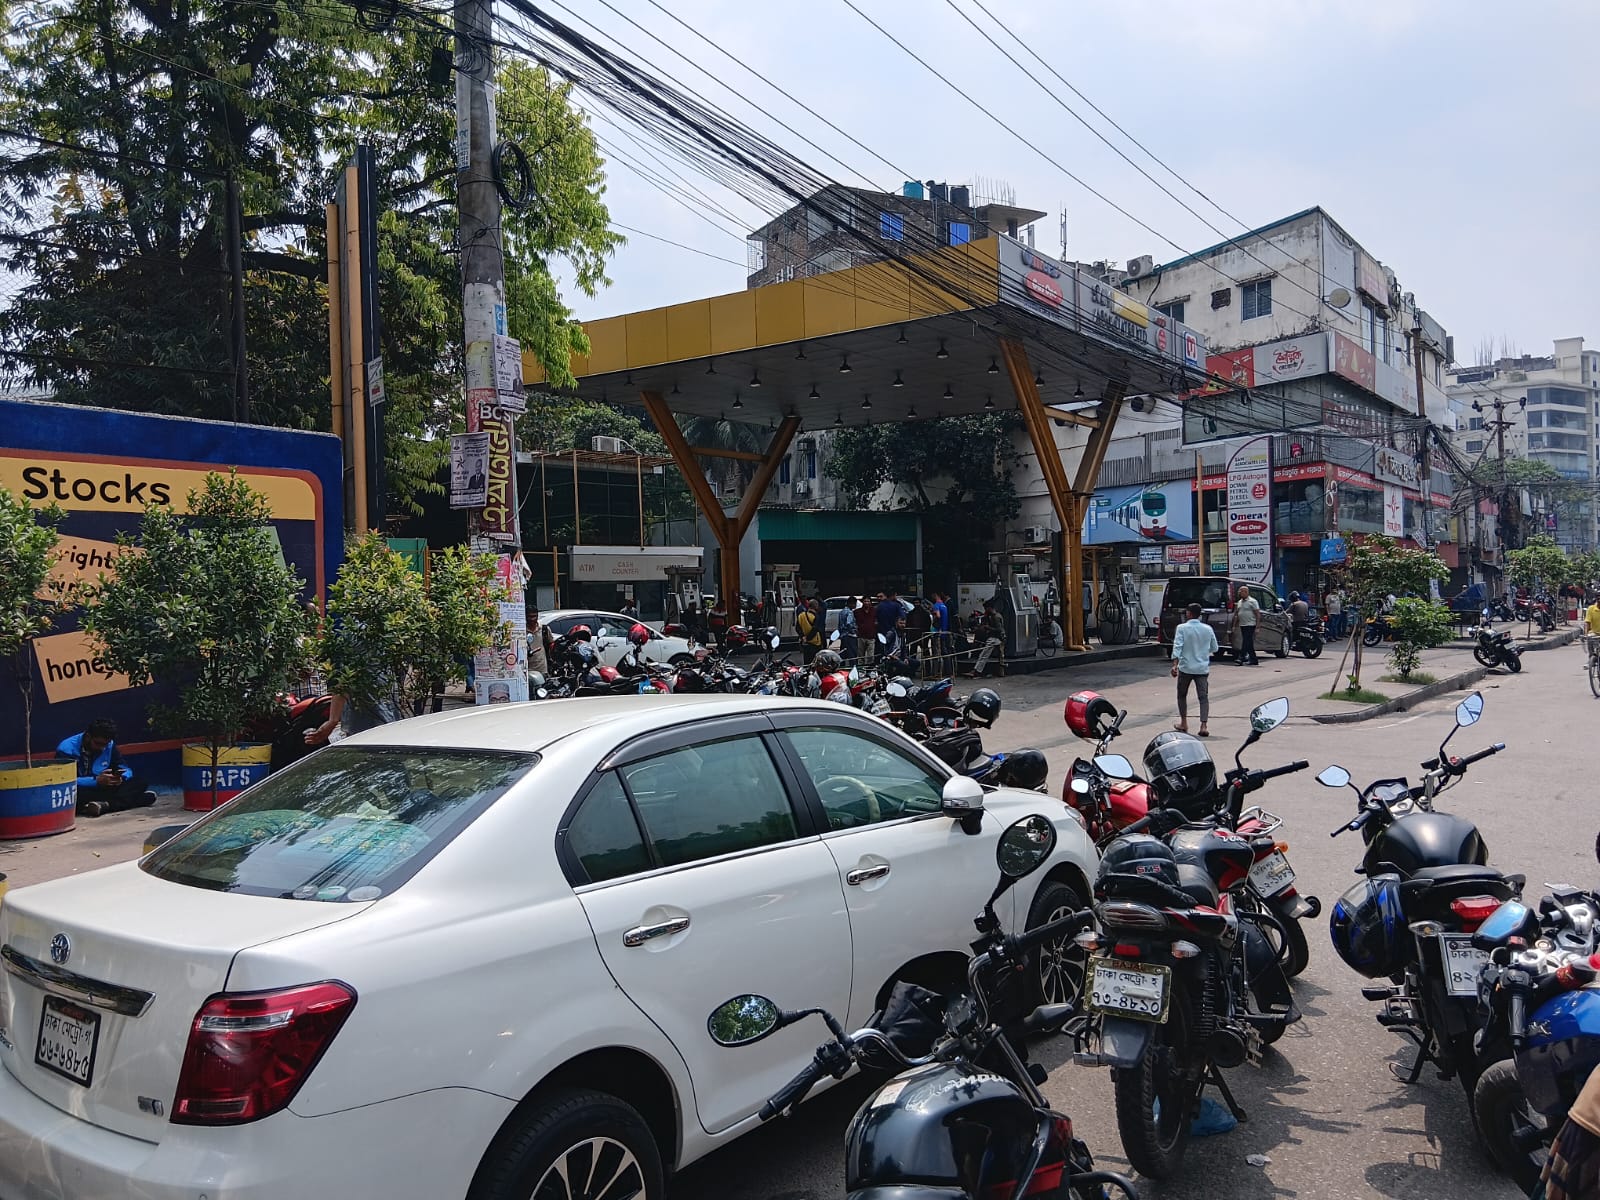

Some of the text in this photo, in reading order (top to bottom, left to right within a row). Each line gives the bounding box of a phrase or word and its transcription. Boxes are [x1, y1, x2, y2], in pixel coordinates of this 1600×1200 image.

[1243, 472, 1267, 481] Autogas
[22, 465, 171, 506] Stocks
[1230, 512, 1263, 521] Omera
[1232, 548, 1265, 556] SERVICING
[579, 564, 595, 573] ATM
[202, 768, 250, 788] DAPS
[1450, 950, 1473, 960] ঢাকা
[1096, 969, 1117, 980] ঢাকা
[45, 1014, 61, 1032] ঢাকা
